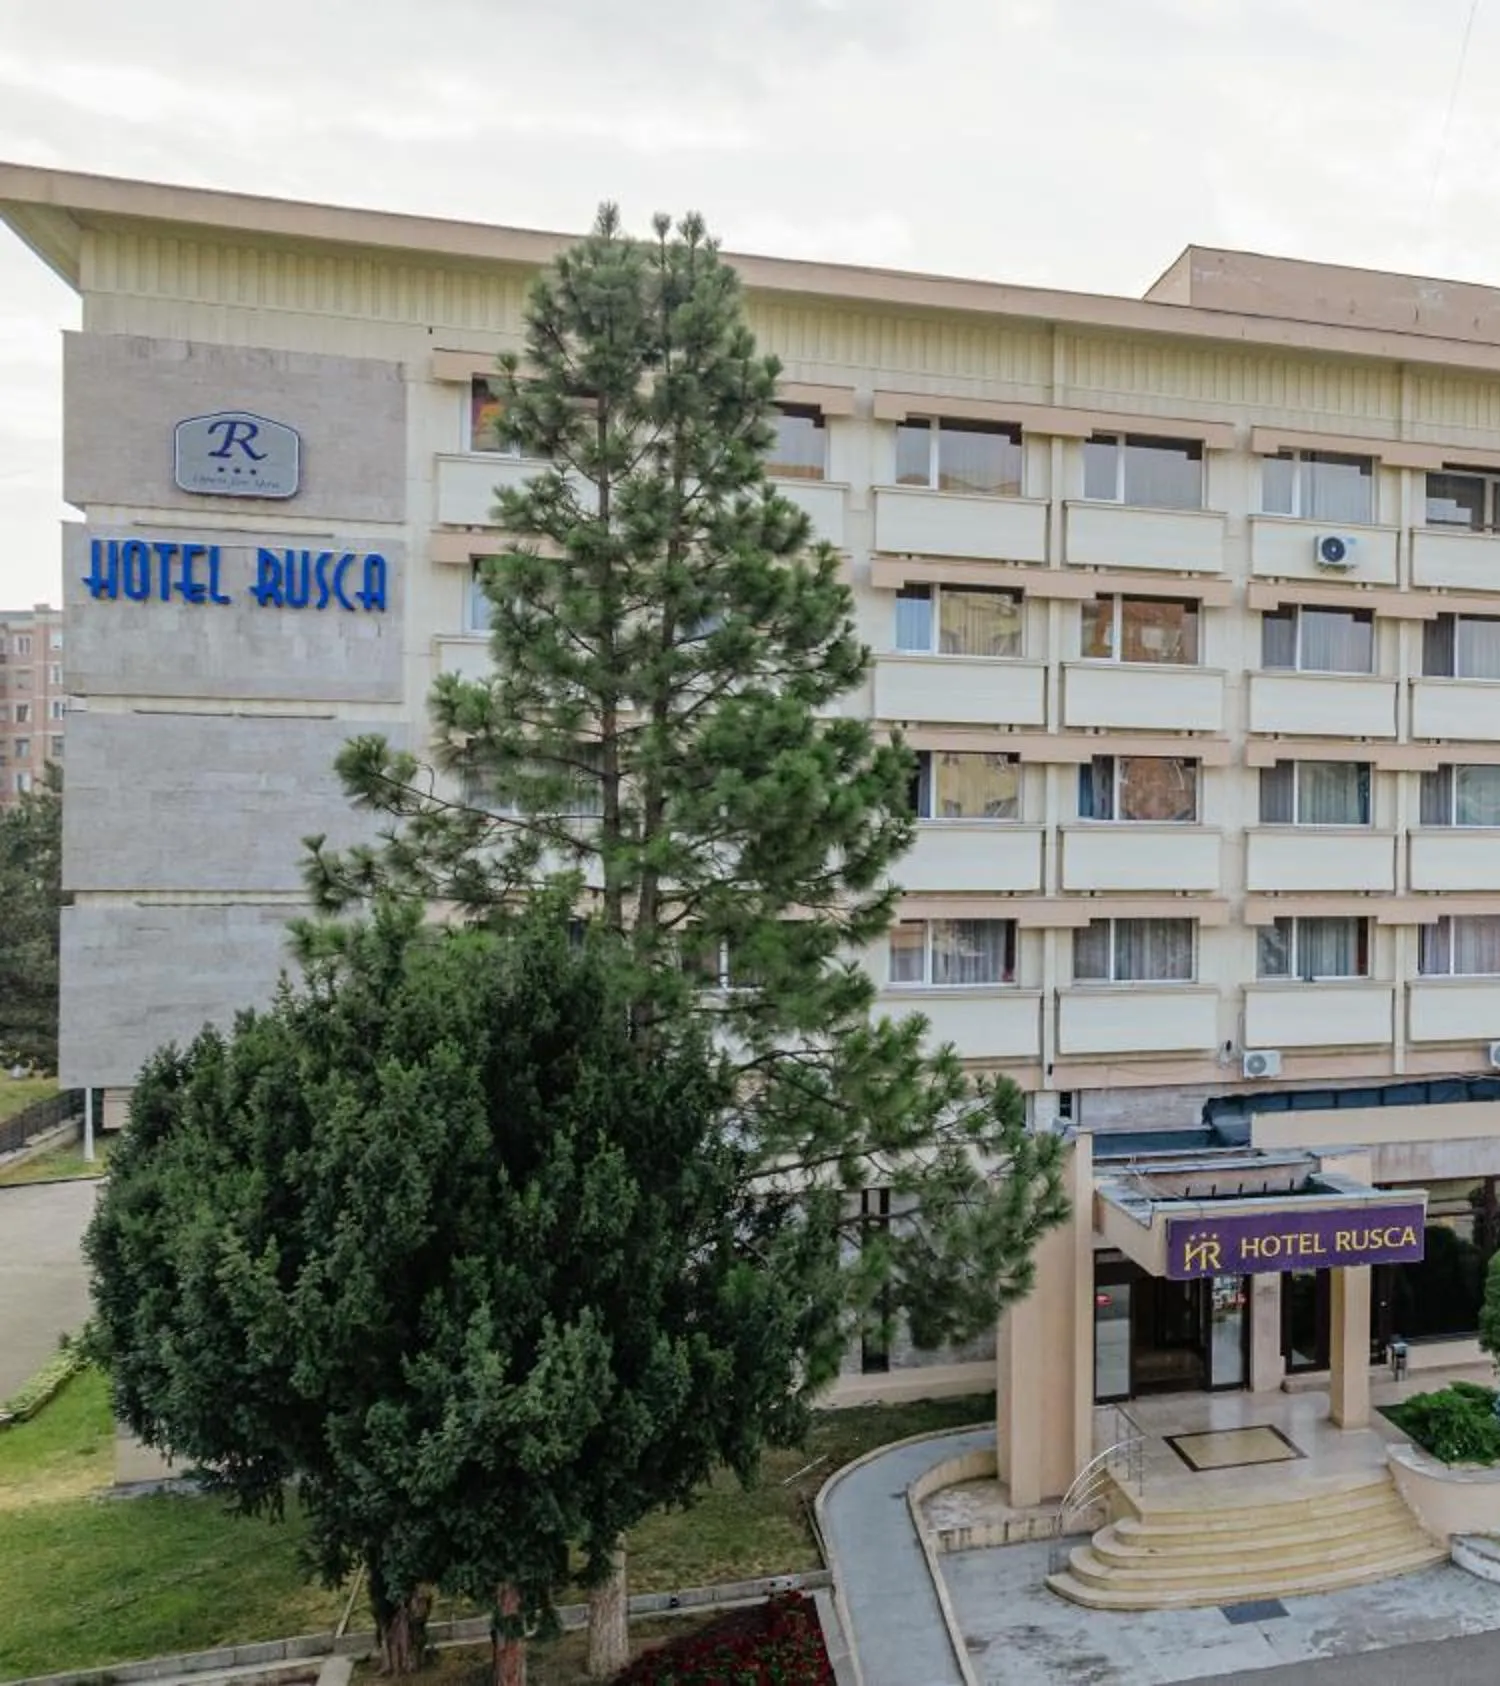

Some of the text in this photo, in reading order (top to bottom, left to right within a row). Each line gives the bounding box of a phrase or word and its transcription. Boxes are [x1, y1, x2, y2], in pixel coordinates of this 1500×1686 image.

[208, 421, 268, 461] R
[82, 539, 387, 612] HOTEL RUSCA
[1241, 1234, 1326, 1259] HOTEL
[1335, 1225, 1417, 1252] RUSCA
